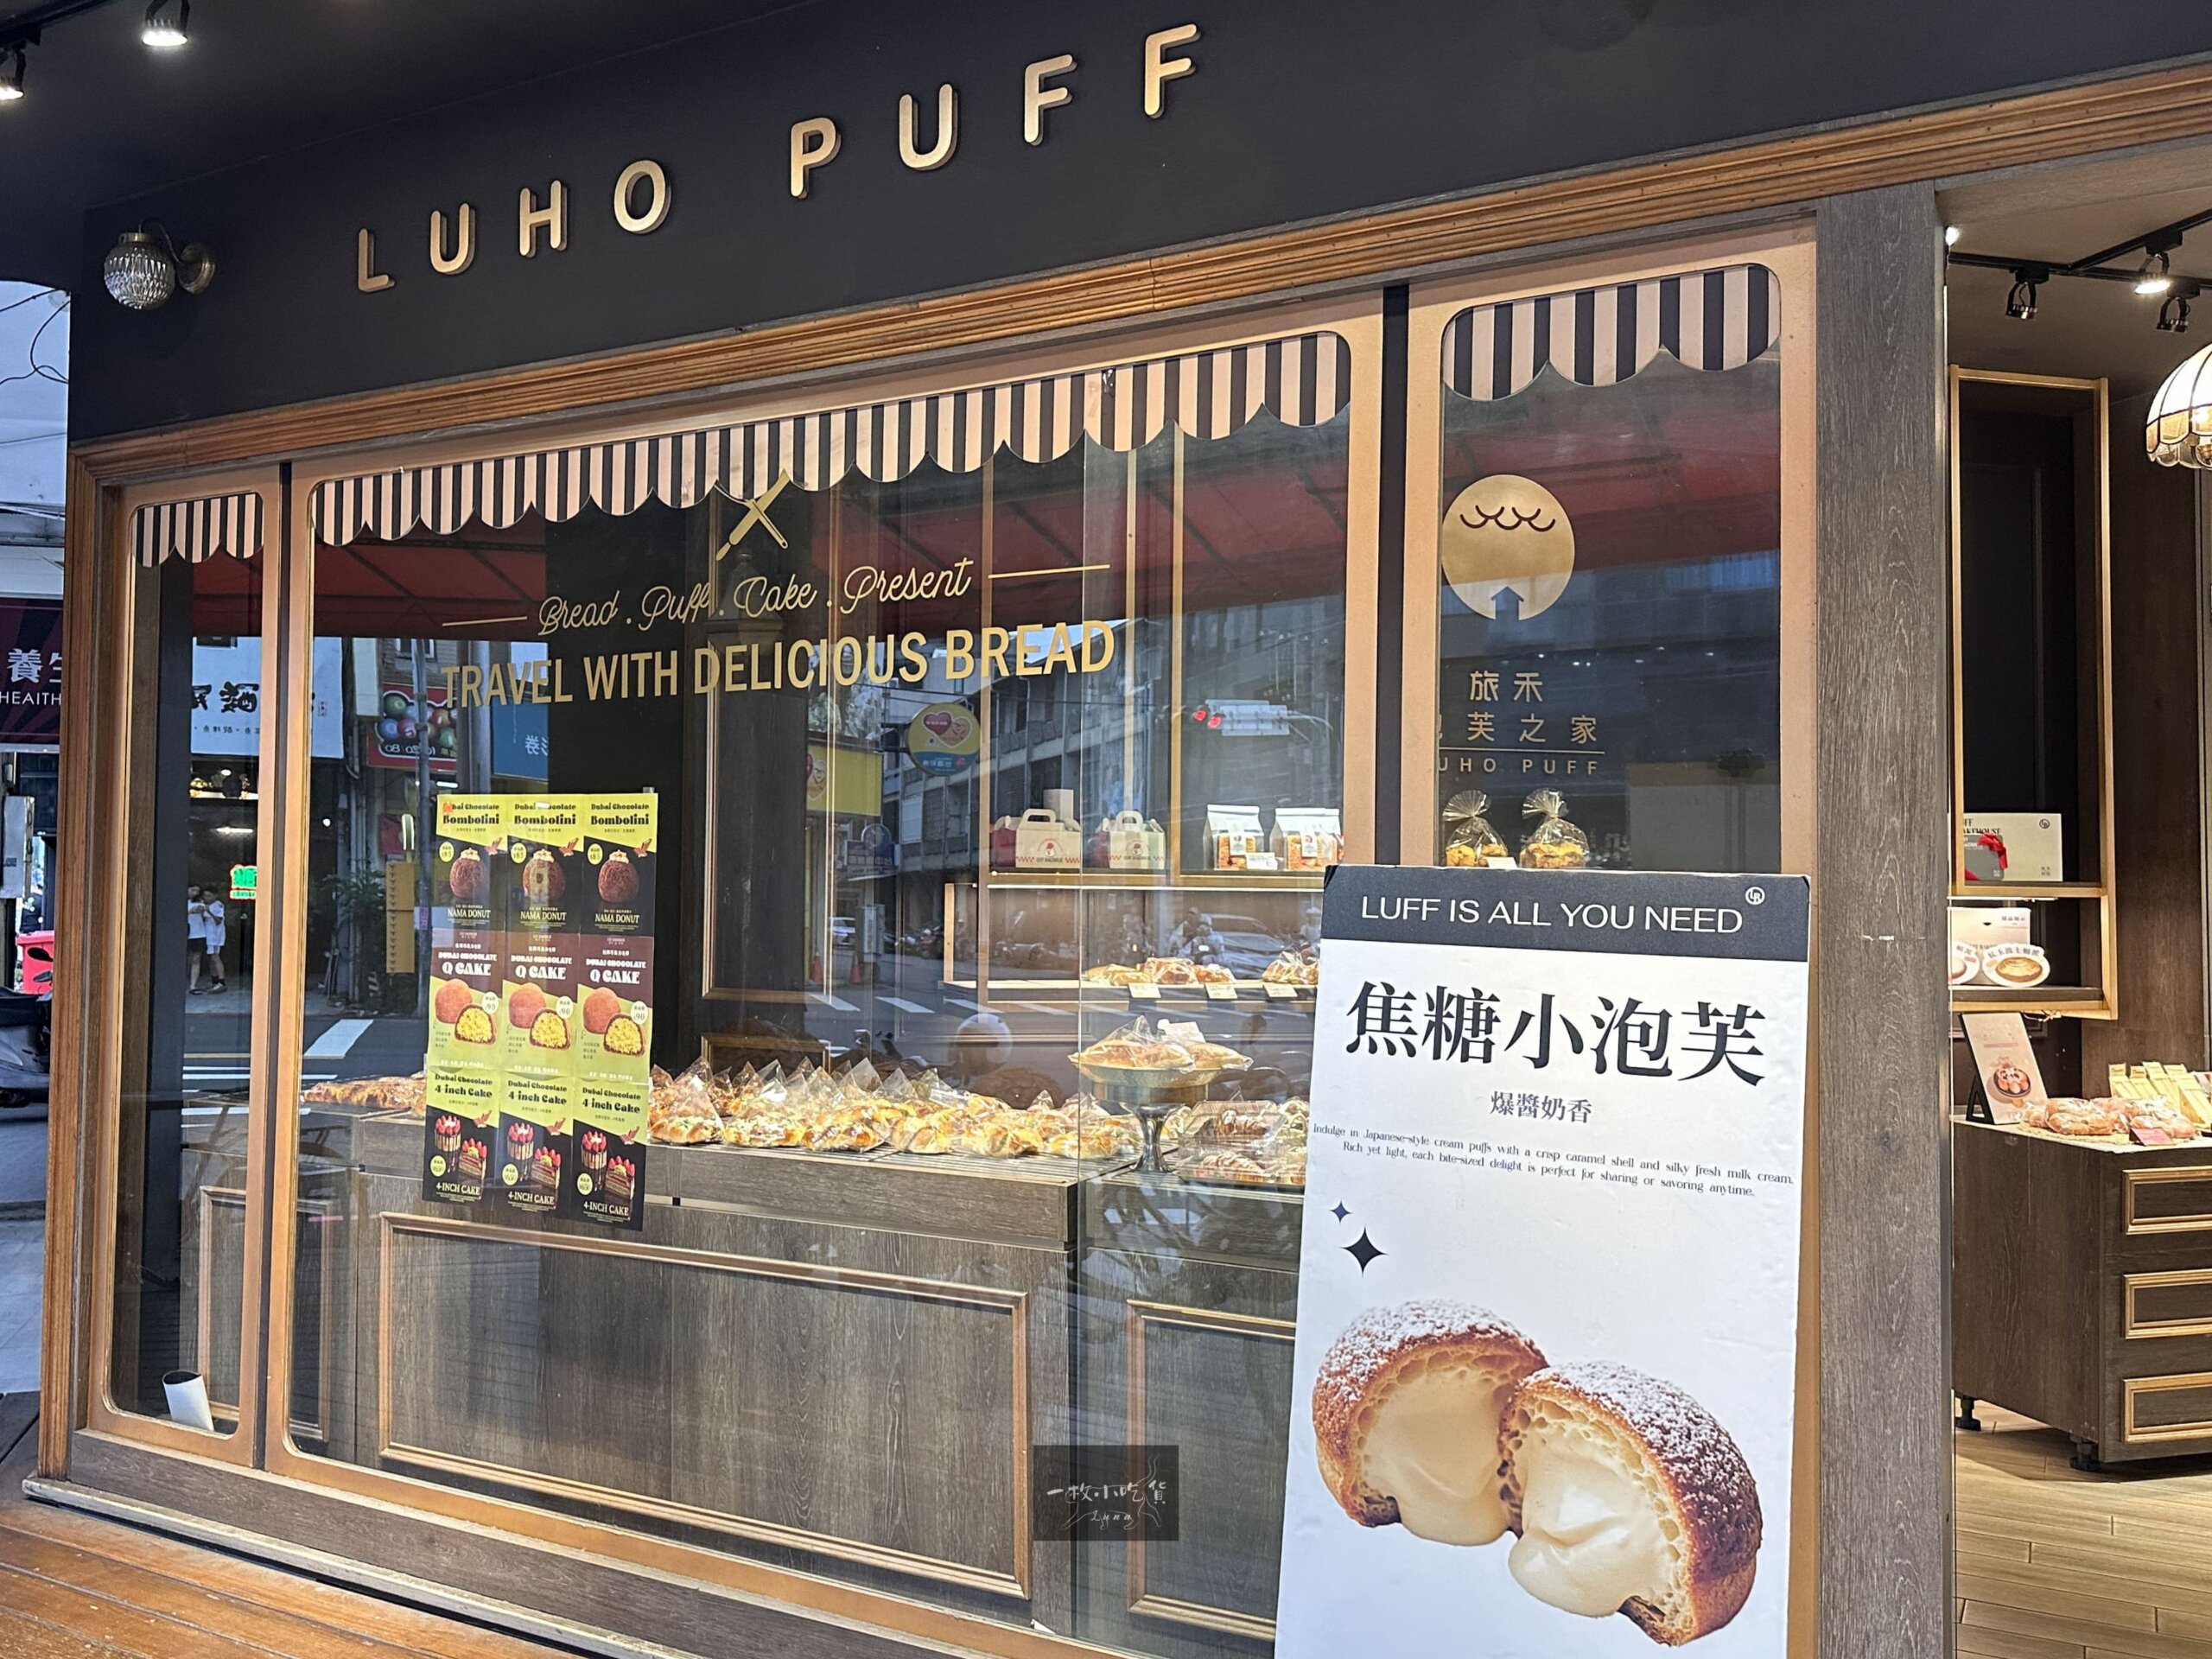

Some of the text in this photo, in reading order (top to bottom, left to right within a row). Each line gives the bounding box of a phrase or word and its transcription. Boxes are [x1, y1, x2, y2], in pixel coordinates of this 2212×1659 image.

[358, 23, 1202, 292] LUHO PUFF
[537, 556, 974, 636] Bread Puff Cake Present
[442, 620, 1115, 709] TRAVEL WITH DELICIOUS BREAD
[1470, 671, 1543, 702] 旅禾
[1439, 711, 1597, 744] 芙之家
[1438, 757, 1598, 775] UHO PUFF
[442, 813, 499, 824] Bombolini
[514, 813, 576, 825] Bombolini
[590, 813, 649, 825] Bombolini
[448, 908, 491, 918] NAMA DONUT
[520, 911, 567, 921] NAMA DONUT
[594, 913, 639, 924] NAMA DONUT
[1362, 895, 1743, 934] LUFF IS ALL YOU NEED
[460, 952, 497, 961] CHOCOLATE
[534, 956, 572, 965] CHOCOLATE
[442, 962, 492, 976] Q CAKE
[607, 959, 646, 969] CHOCOLATE
[515, 964, 566, 980] Q CAKE
[589, 969, 640, 984] Q CAKE
[1345, 981, 1766, 1087] 焦糖小泡芙
[435, 1073, 493, 1085] Dubai Chocolate
[467, 1087, 493, 1098] Cake
[508, 1080, 567, 1092] Dubai Chocolate
[542, 1094, 567, 1105] Cake
[582, 1087, 641, 1100] Dubai Chocolate
[614, 1102, 640, 1114] Cake
[1490, 1090, 1592, 1124] 爆醬奶香
[1313, 1123, 1346, 1136] Indulge
[1350, 1129, 1358, 1138] in
[1363, 1128, 1429, 1147] Japanese-style
[1433, 1138, 1464, 1150] cream
[1469, 1141, 1491, 1154] puffs
[1497, 1144, 1519, 1156] with
[1535, 1148, 1560, 1162] crisp
[1566, 1153, 1605, 1165] caramel
[1611, 1156, 1634, 1168] shell
[1639, 1160, 1660, 1171] and
[1665, 1160, 1690, 1175] silky
[1694, 1164, 1721, 1178] fresh
[1727, 1168, 1751, 1180] milk
[1757, 1173, 1795, 1185] cream.
[1343, 1141, 1755, 1198] Rich yet light, each bite-sized delight is perfect for sharing or savoring anytime.
[435, 1182, 481, 1195] 4-INCH CAKE
[508, 1191, 555, 1205] 4-INCH CAKE
[583, 1201, 629, 1217] 4-INCH CAKE
